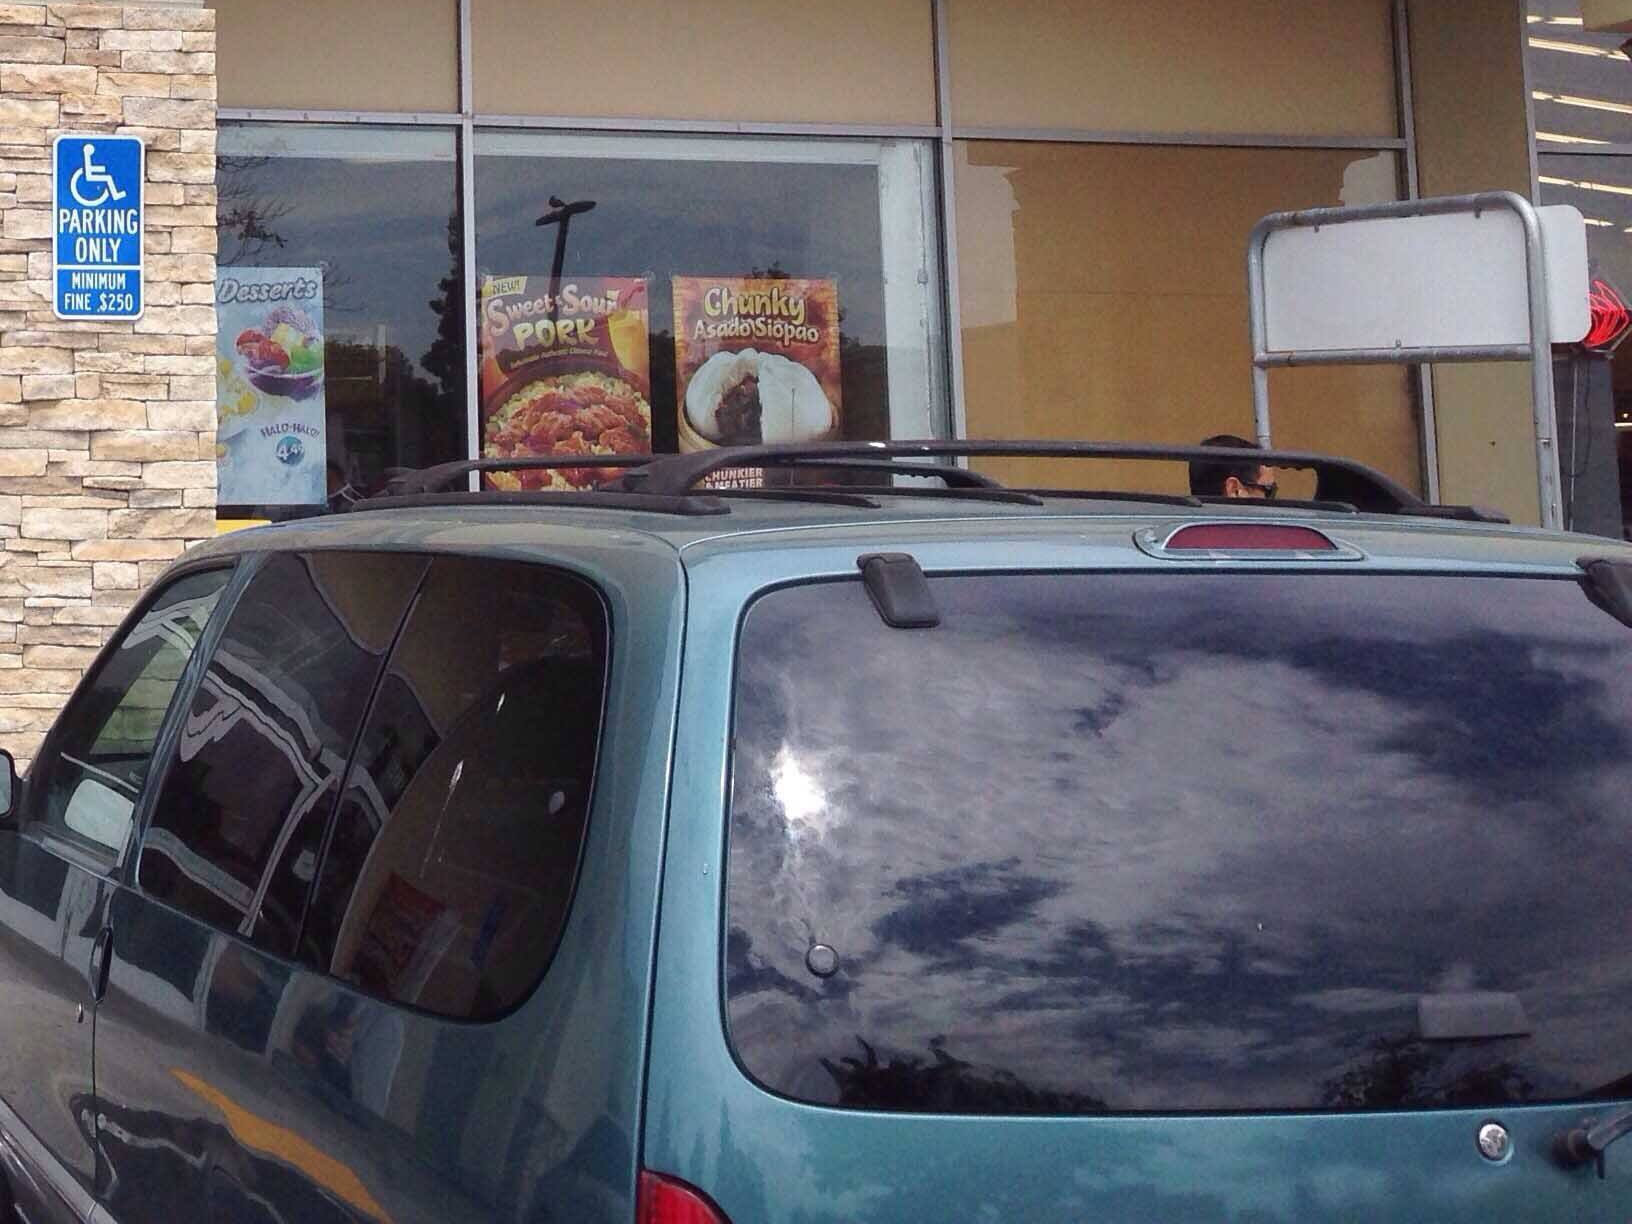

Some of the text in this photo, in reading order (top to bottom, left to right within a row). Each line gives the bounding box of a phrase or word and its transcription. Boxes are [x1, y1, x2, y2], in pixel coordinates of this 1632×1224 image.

[59, 209, 138, 234] PARKING
[75, 237, 122, 263] ONLY
[71, 272, 126, 290] MINIMUM
[218, 277, 318, 304] Desserts
[492, 279, 521, 294] NEW!
[64, 293, 133, 312] FINE $250
[487, 295, 555, 336] Sweet
[562, 283, 618, 314] Sour
[704, 287, 806, 325] Chunky
[512, 319, 599, 350] PORK
[693, 318, 751, 340] Asado
